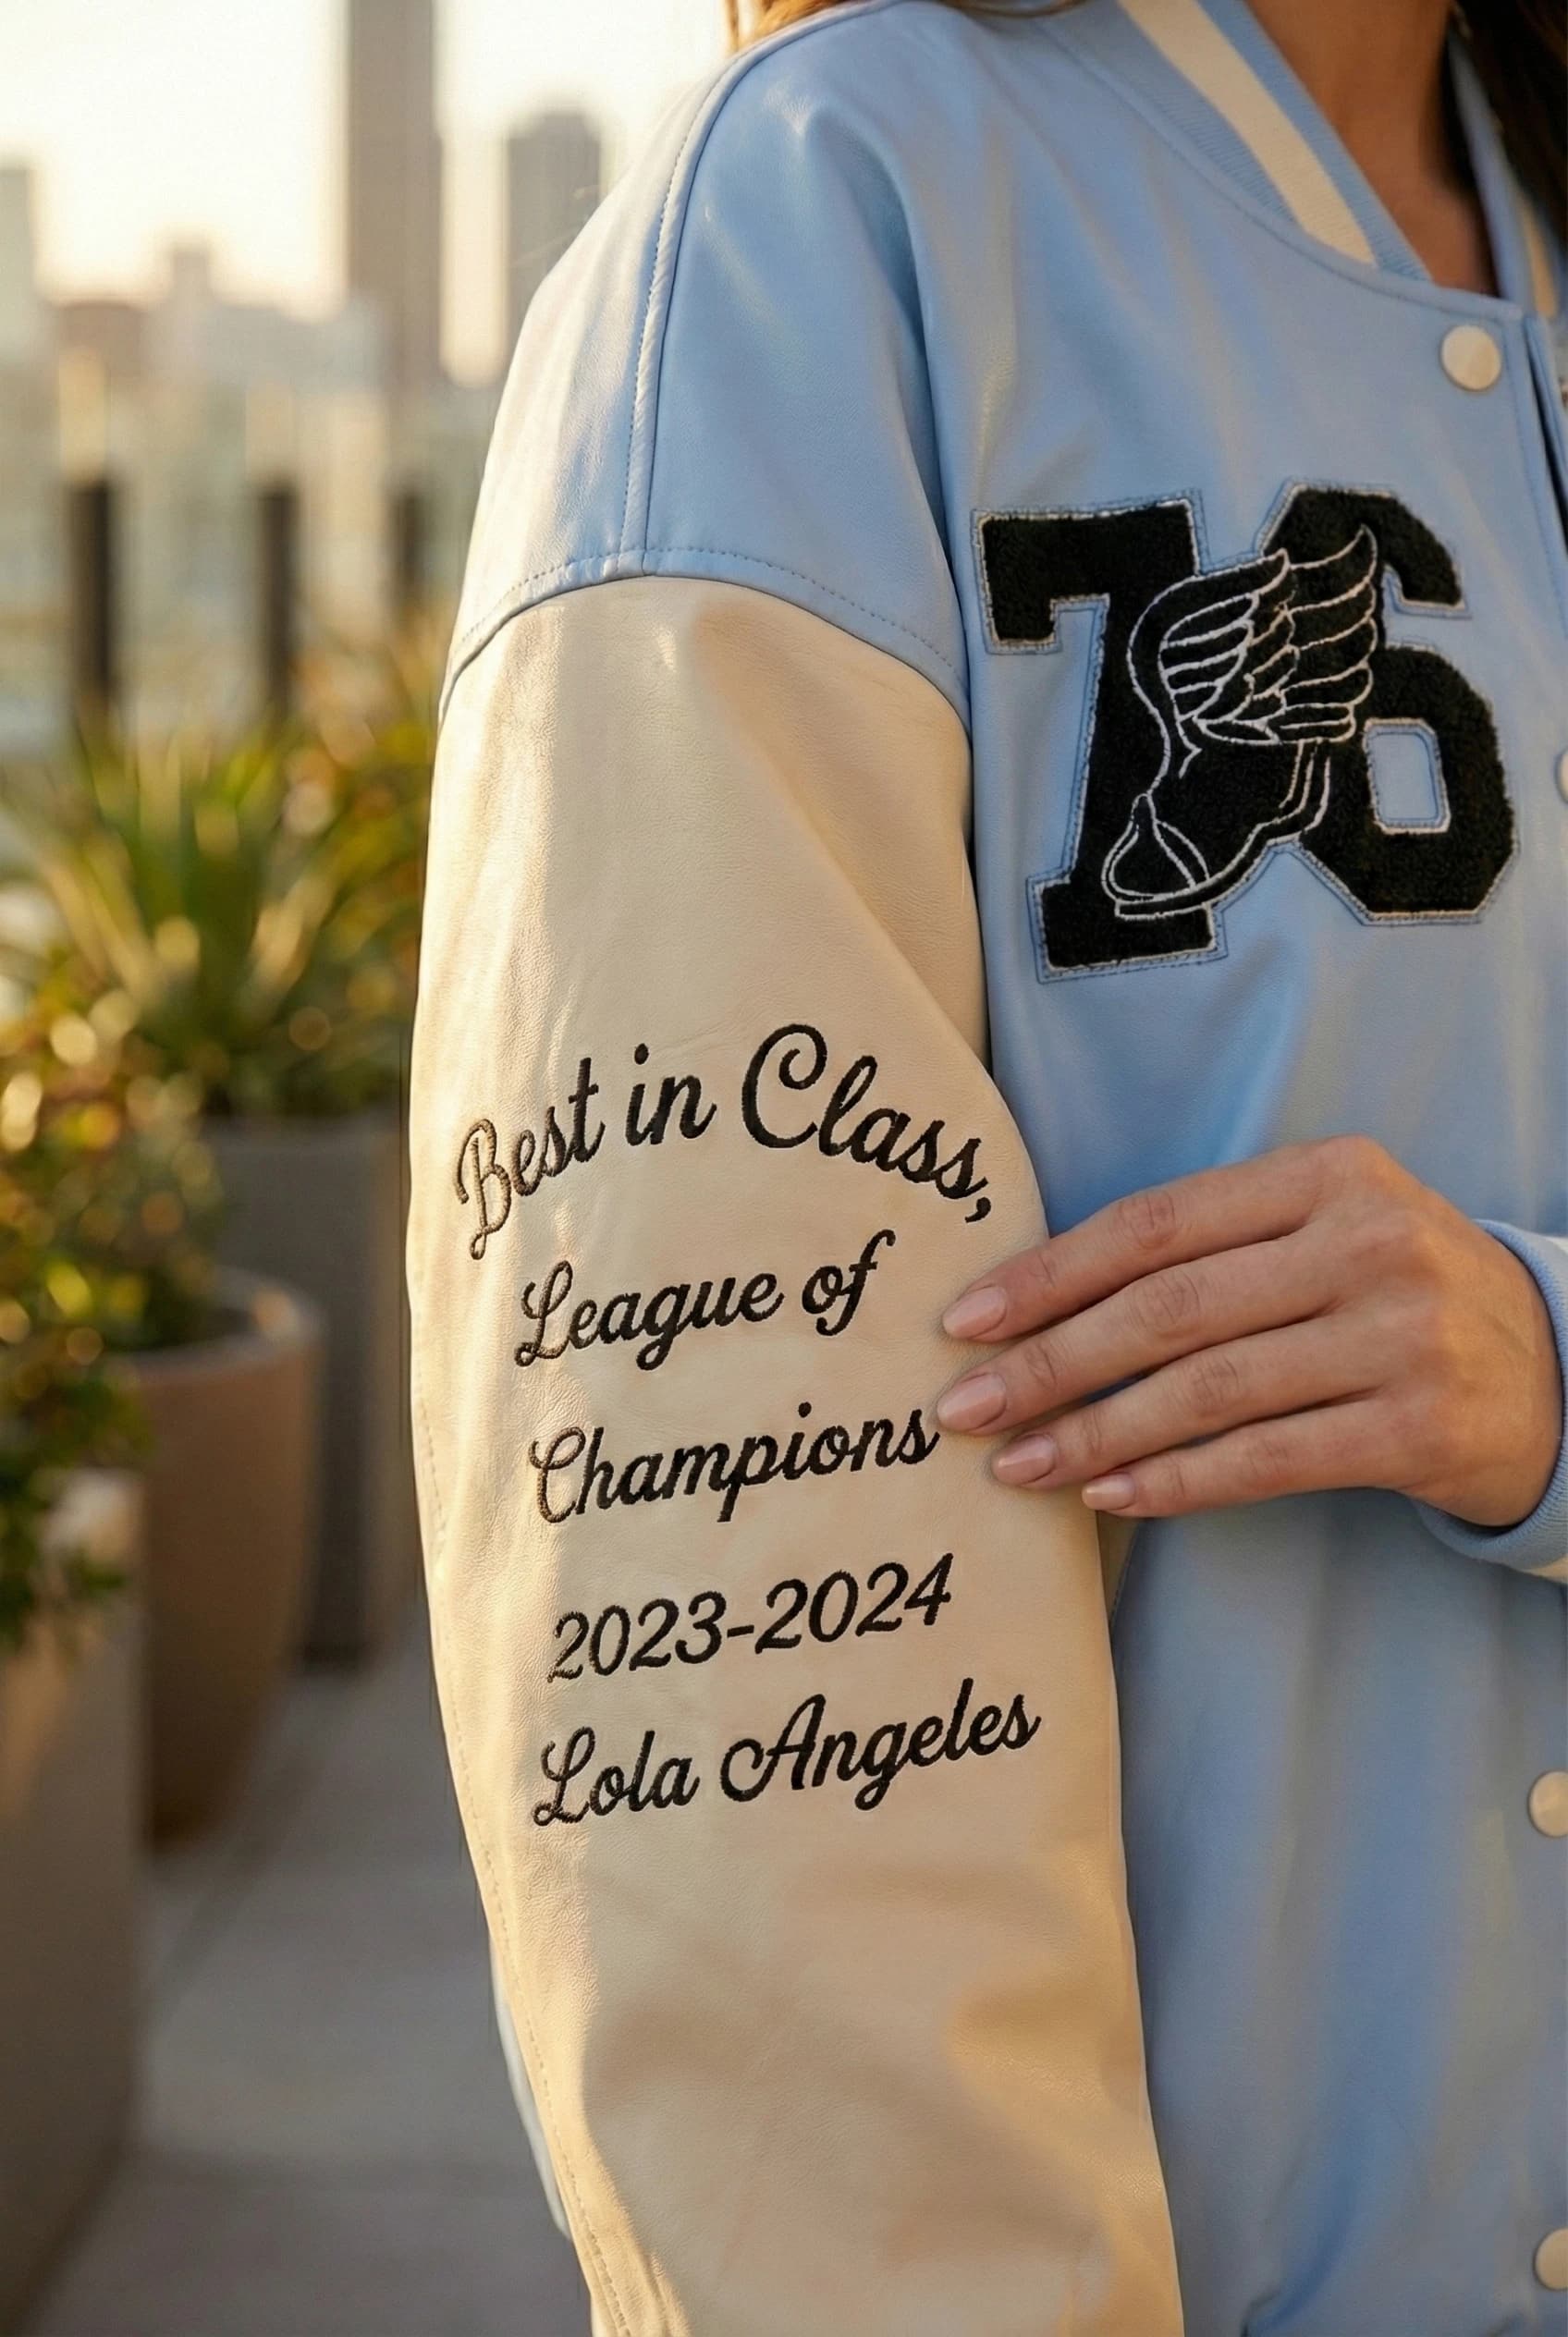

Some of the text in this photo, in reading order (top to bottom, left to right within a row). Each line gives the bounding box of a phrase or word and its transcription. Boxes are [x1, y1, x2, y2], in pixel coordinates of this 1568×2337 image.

[976, 482, 1518, 973] 76
[455, 1023, 992, 1260] Best in Class,
[514, 1229, 896, 1371] League of
[528, 1401, 940, 1523] Champions
[546, 1553, 954, 1683] 2023-2024
[533, 1678, 1042, 1827] Lola Angeles
